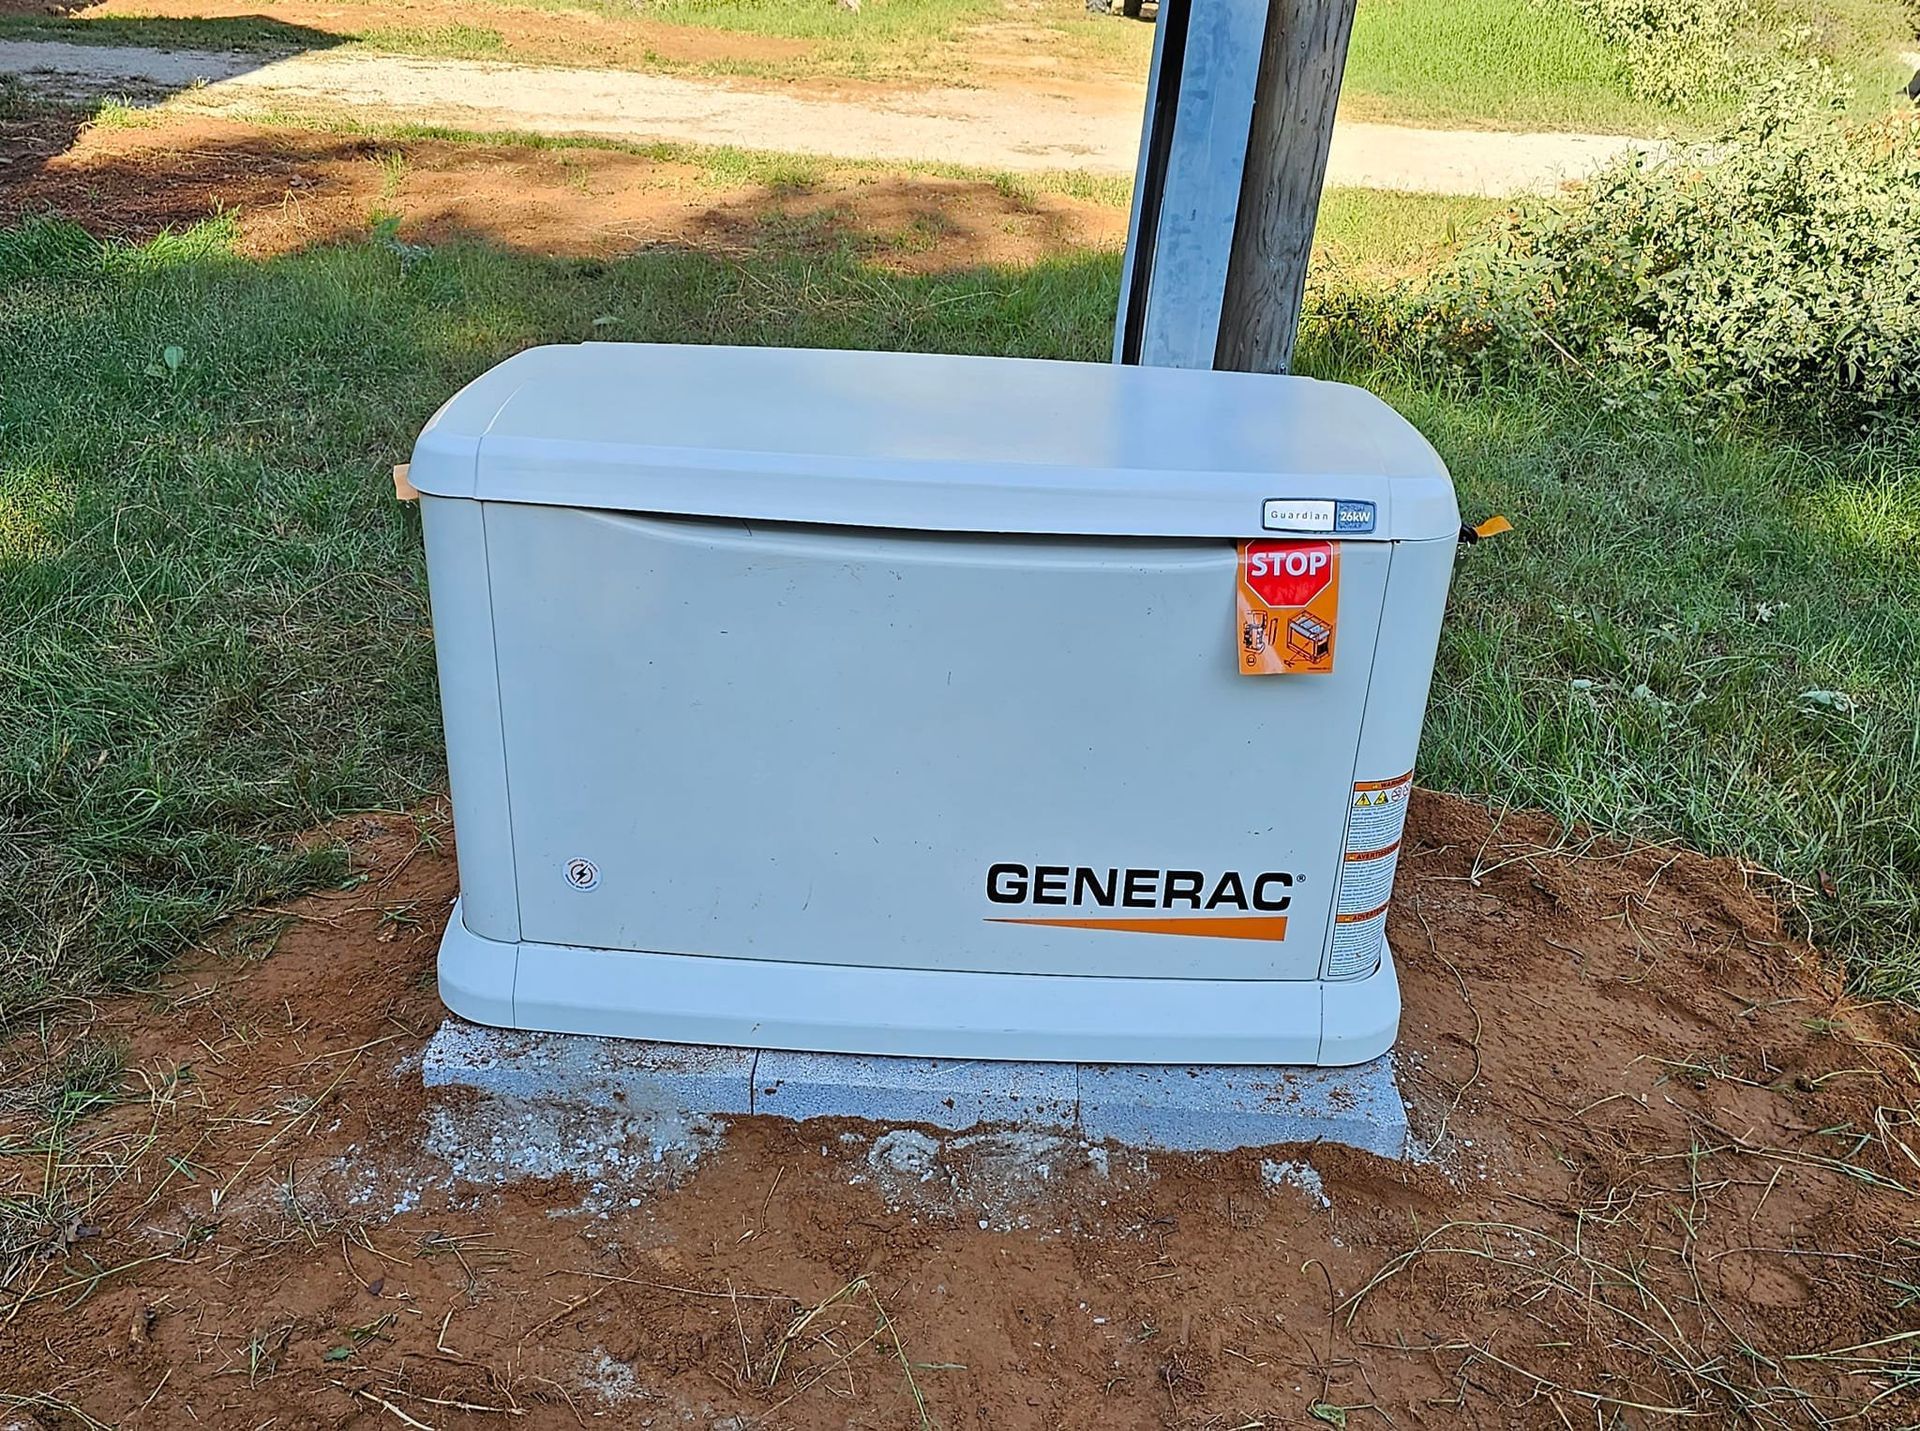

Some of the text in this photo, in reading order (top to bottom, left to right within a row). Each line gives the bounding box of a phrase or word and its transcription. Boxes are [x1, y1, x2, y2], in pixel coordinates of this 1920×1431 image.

[1270, 510, 1328, 520] Guardian
[1340, 511, 1371, 522] 26kW
[1251, 551, 1327, 577] STOP
